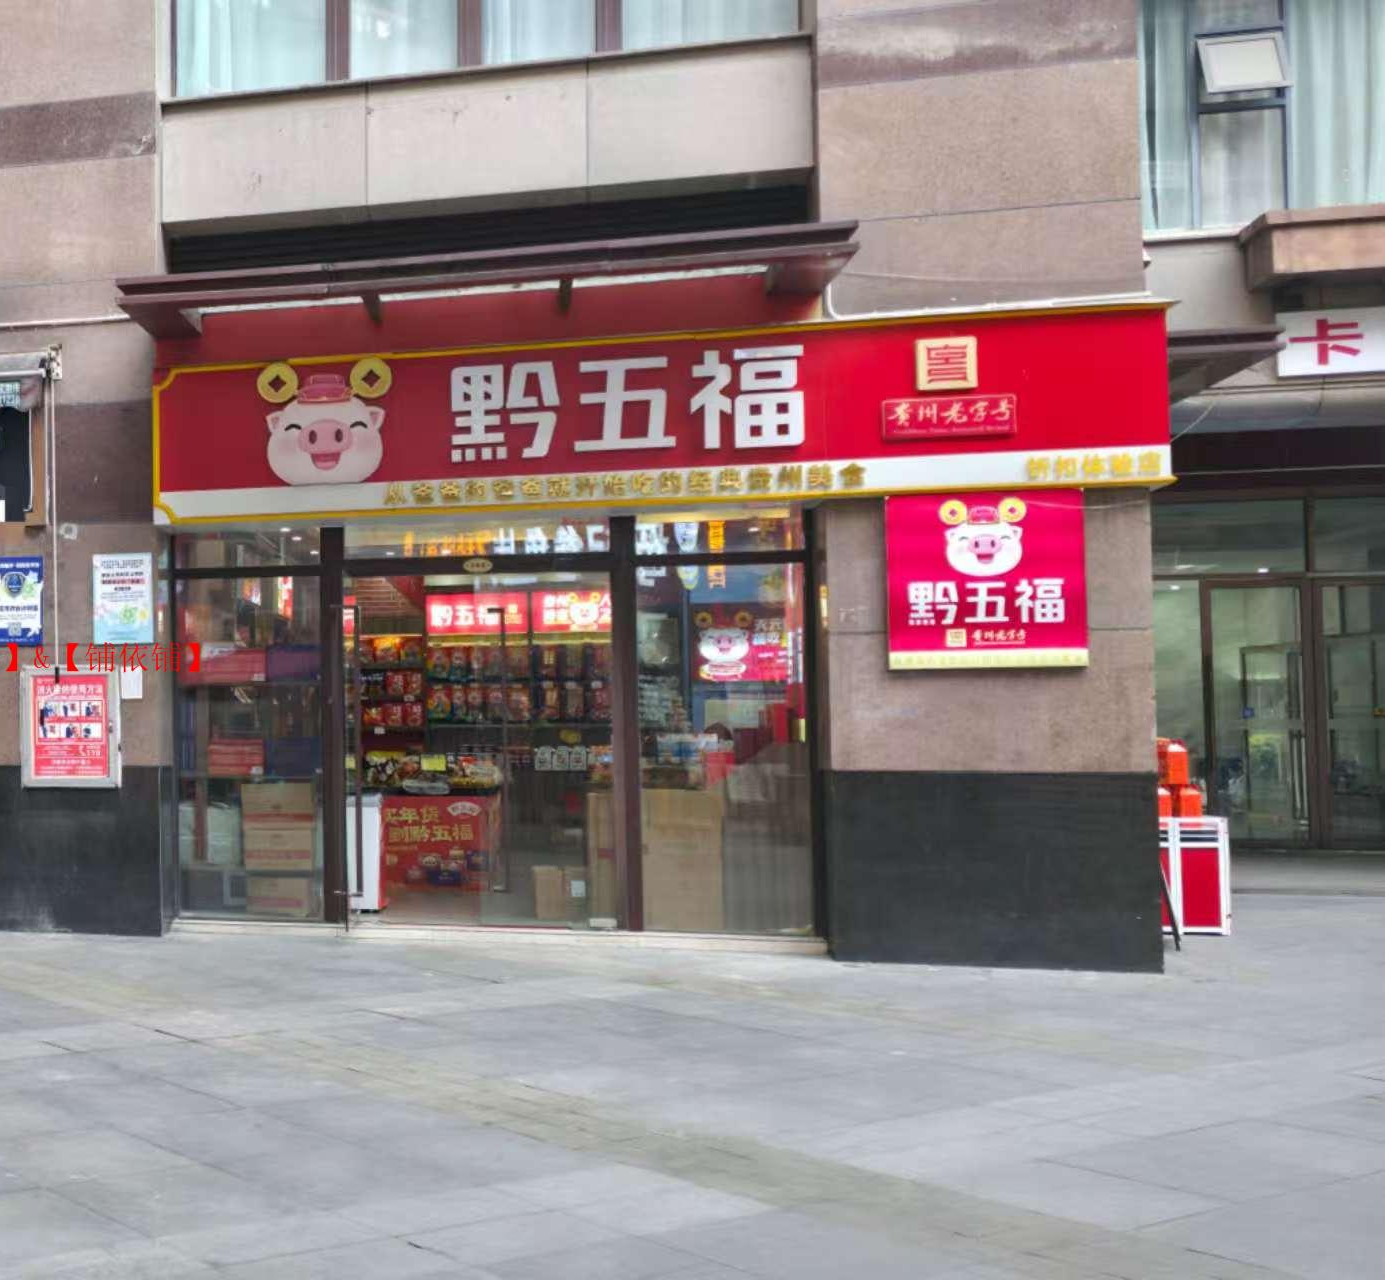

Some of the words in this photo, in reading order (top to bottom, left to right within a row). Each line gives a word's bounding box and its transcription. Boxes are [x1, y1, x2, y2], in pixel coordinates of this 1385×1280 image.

[1288, 318, 1363, 365] 卡
[450, 345, 805, 462] 黔五福
[908, 578, 1065, 626] 黔五福
